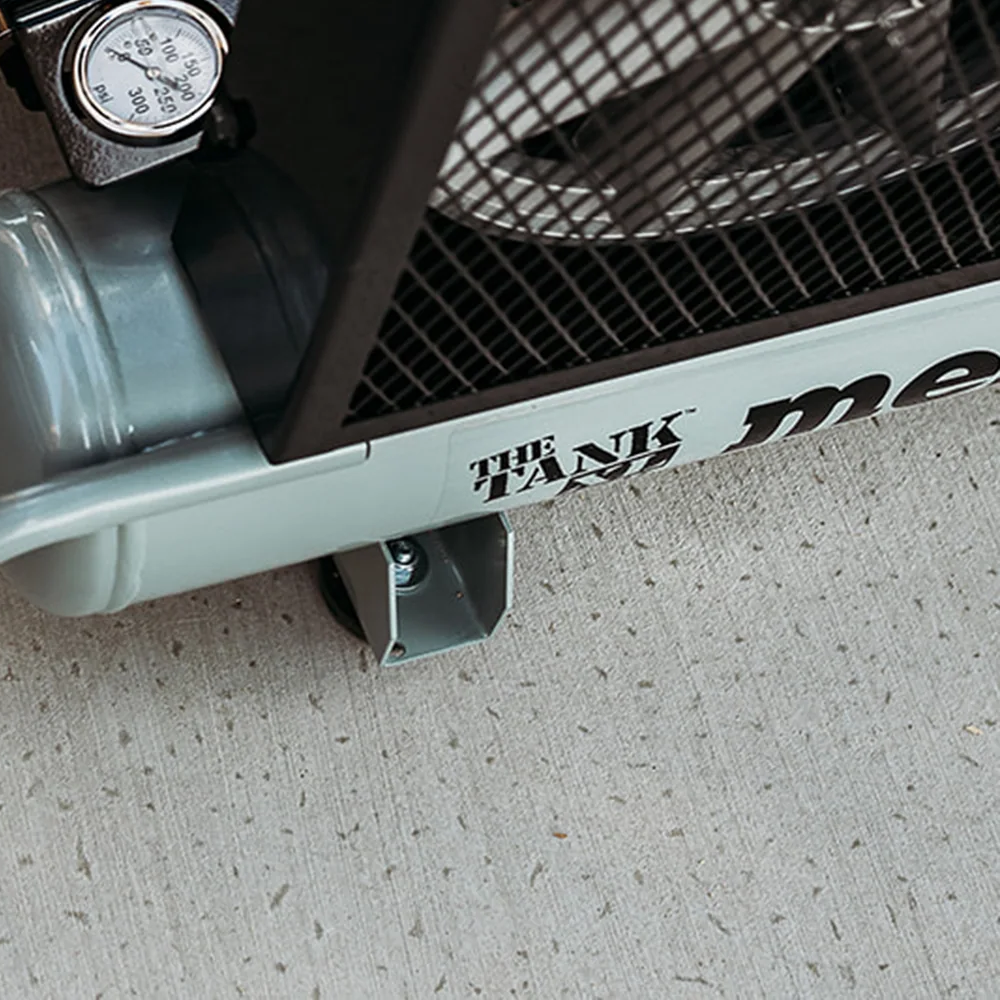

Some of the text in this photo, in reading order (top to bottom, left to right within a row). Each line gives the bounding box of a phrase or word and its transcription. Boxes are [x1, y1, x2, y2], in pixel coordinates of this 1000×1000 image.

[134, 38, 153, 56] 50
[161, 37, 180, 63] 100
[182, 52, 201, 78] 150
[128, 86, 150, 115] 300
[154, 87, 178, 114] 250
[469, 435, 555, 478] THE
[473, 411, 683, 503] TANK
